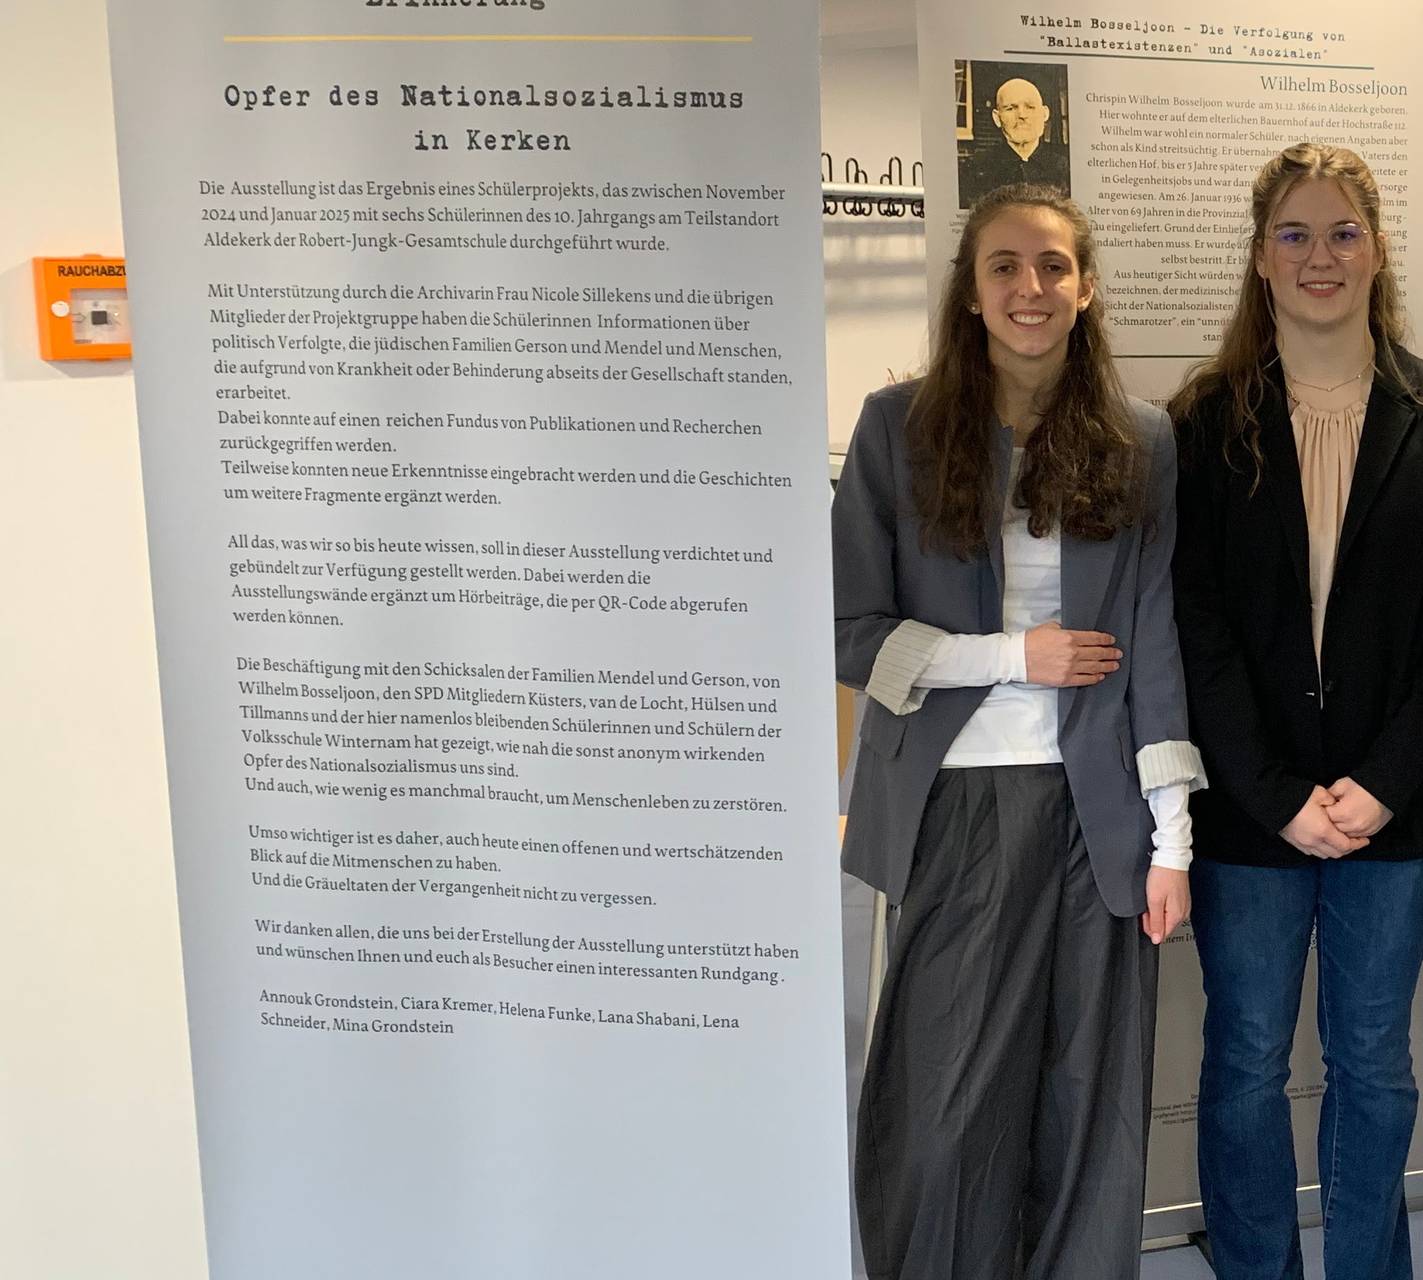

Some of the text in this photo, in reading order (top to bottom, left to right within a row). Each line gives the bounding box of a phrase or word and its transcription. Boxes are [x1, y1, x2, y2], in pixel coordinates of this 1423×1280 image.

[1021, 15, 1081, 28] Wilhelm
[1091, 18, 1174, 33] Bosseljoon
[1200, 24, 1223, 35] Die
[1235, 26, 1312, 41] Verfolgung
[1323, 33, 1344, 41] von
[1209, 45, 1232, 55] und
[224, 84, 743, 111] Opfer des Nationalsozialismus
[1261, 76, 1407, 98] Wilhelm Bosseljoon
[1086, 92, 1126, 106] Chrispin
[1128, 94, 1170, 105] Wilhelm
[1173, 96, 1222, 108] Bosseljoon
[1226, 99, 1255, 109] wurde
[1298, 102, 1316, 111] 1866
[1318, 103, 1326, 111] in
[1329, 103, 1368, 113] Aldekerk
[414, 129, 571, 151] in Kerken
[1091, 141, 1118, 152] schon
[1121, 142, 1133, 152] als
[1135, 143, 1157, 153] Kind
[1222, 146, 1232, 155] Er
[1360, 151, 1407, 160] Vaters den
[200, 180, 785, 202] Die Ausstellung ist das Ergebnis eines Schülerprojekts, das zwischen November
[1099, 192, 1241, 203] angewiesen. Am 26. Januar 1936
[202, 205, 779, 229] 2024 und Januar 2025 mit sechs Schülerinnen des 10. Jahrgangs am Teilstandort
[1087, 205, 1110, 215] Alter
[1131, 207, 1141, 217] 69
[1143, 207, 1174, 218] Jahren
[1176, 208, 1185, 216] in
[1187, 208, 1200, 217] die
[204, 231, 669, 254] Aldekerk der Robert-Jungk-Gesamtschule durchgeführt wurde.
[57, 265, 126, 277] RAUCHABZ
[1114, 269, 1237, 281] Aus heutiger Sicht würden
[1181, 318, 1195, 326] ein
[237, 657, 780, 688] Die Beschäftigung mit den Schicksalen der Familien Mendel und Gerson, von
[239, 680, 777, 713] Wilhelm Bosseljoon, den SPD Mitgliedern Küsters, van de Locht, Hülsen und
[251, 847, 500, 871] Blick auf die Mitmenschen zu haben.
[260, 989, 739, 1030] Annouk Grondstein, Ciara Kremer, Helena Funke, Lana Shabani, Lena
[261, 1011, 453, 1034] Schneider, Mina Grondstein
